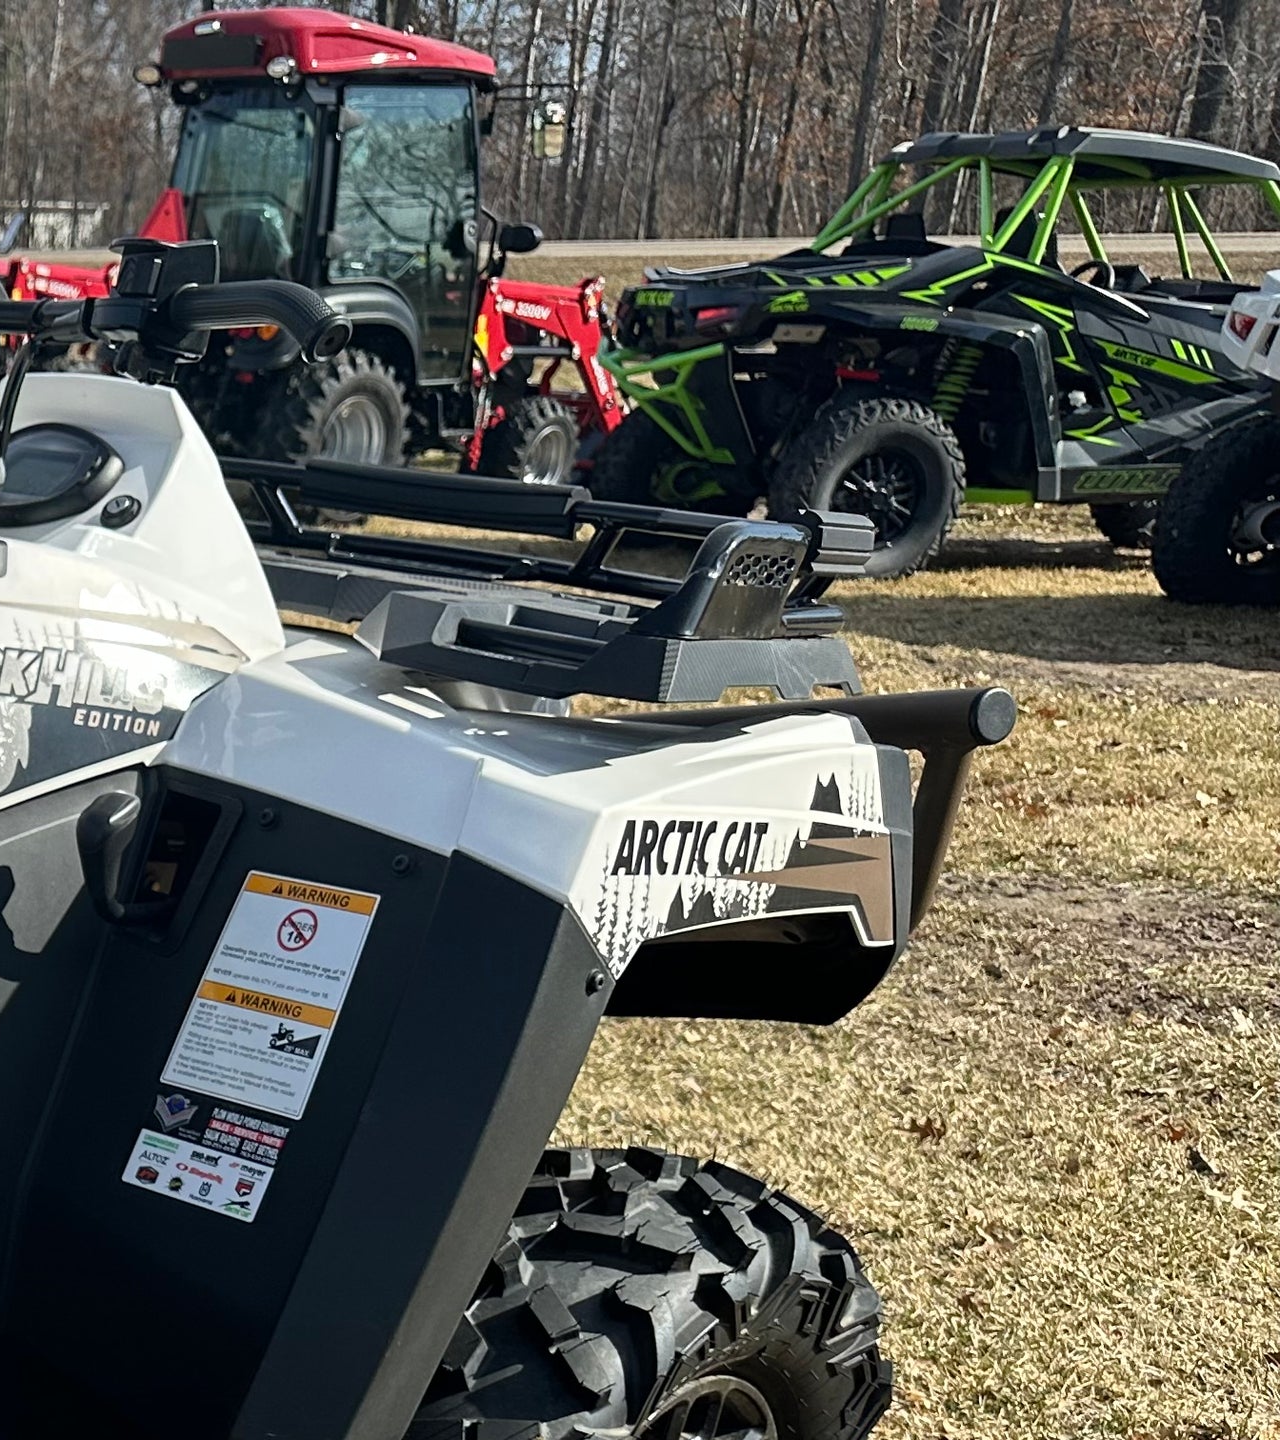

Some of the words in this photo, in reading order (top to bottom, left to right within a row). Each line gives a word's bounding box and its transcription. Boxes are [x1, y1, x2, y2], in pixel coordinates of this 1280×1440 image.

[73, 708, 161, 737] EDITION
[610, 819, 717, 876] ARCTIC
[717, 821, 769, 874] CAT
[287, 884, 351, 908] WARNING
[239, 992, 303, 1018] WARNING
[240, 1164, 267, 1177] meyer
